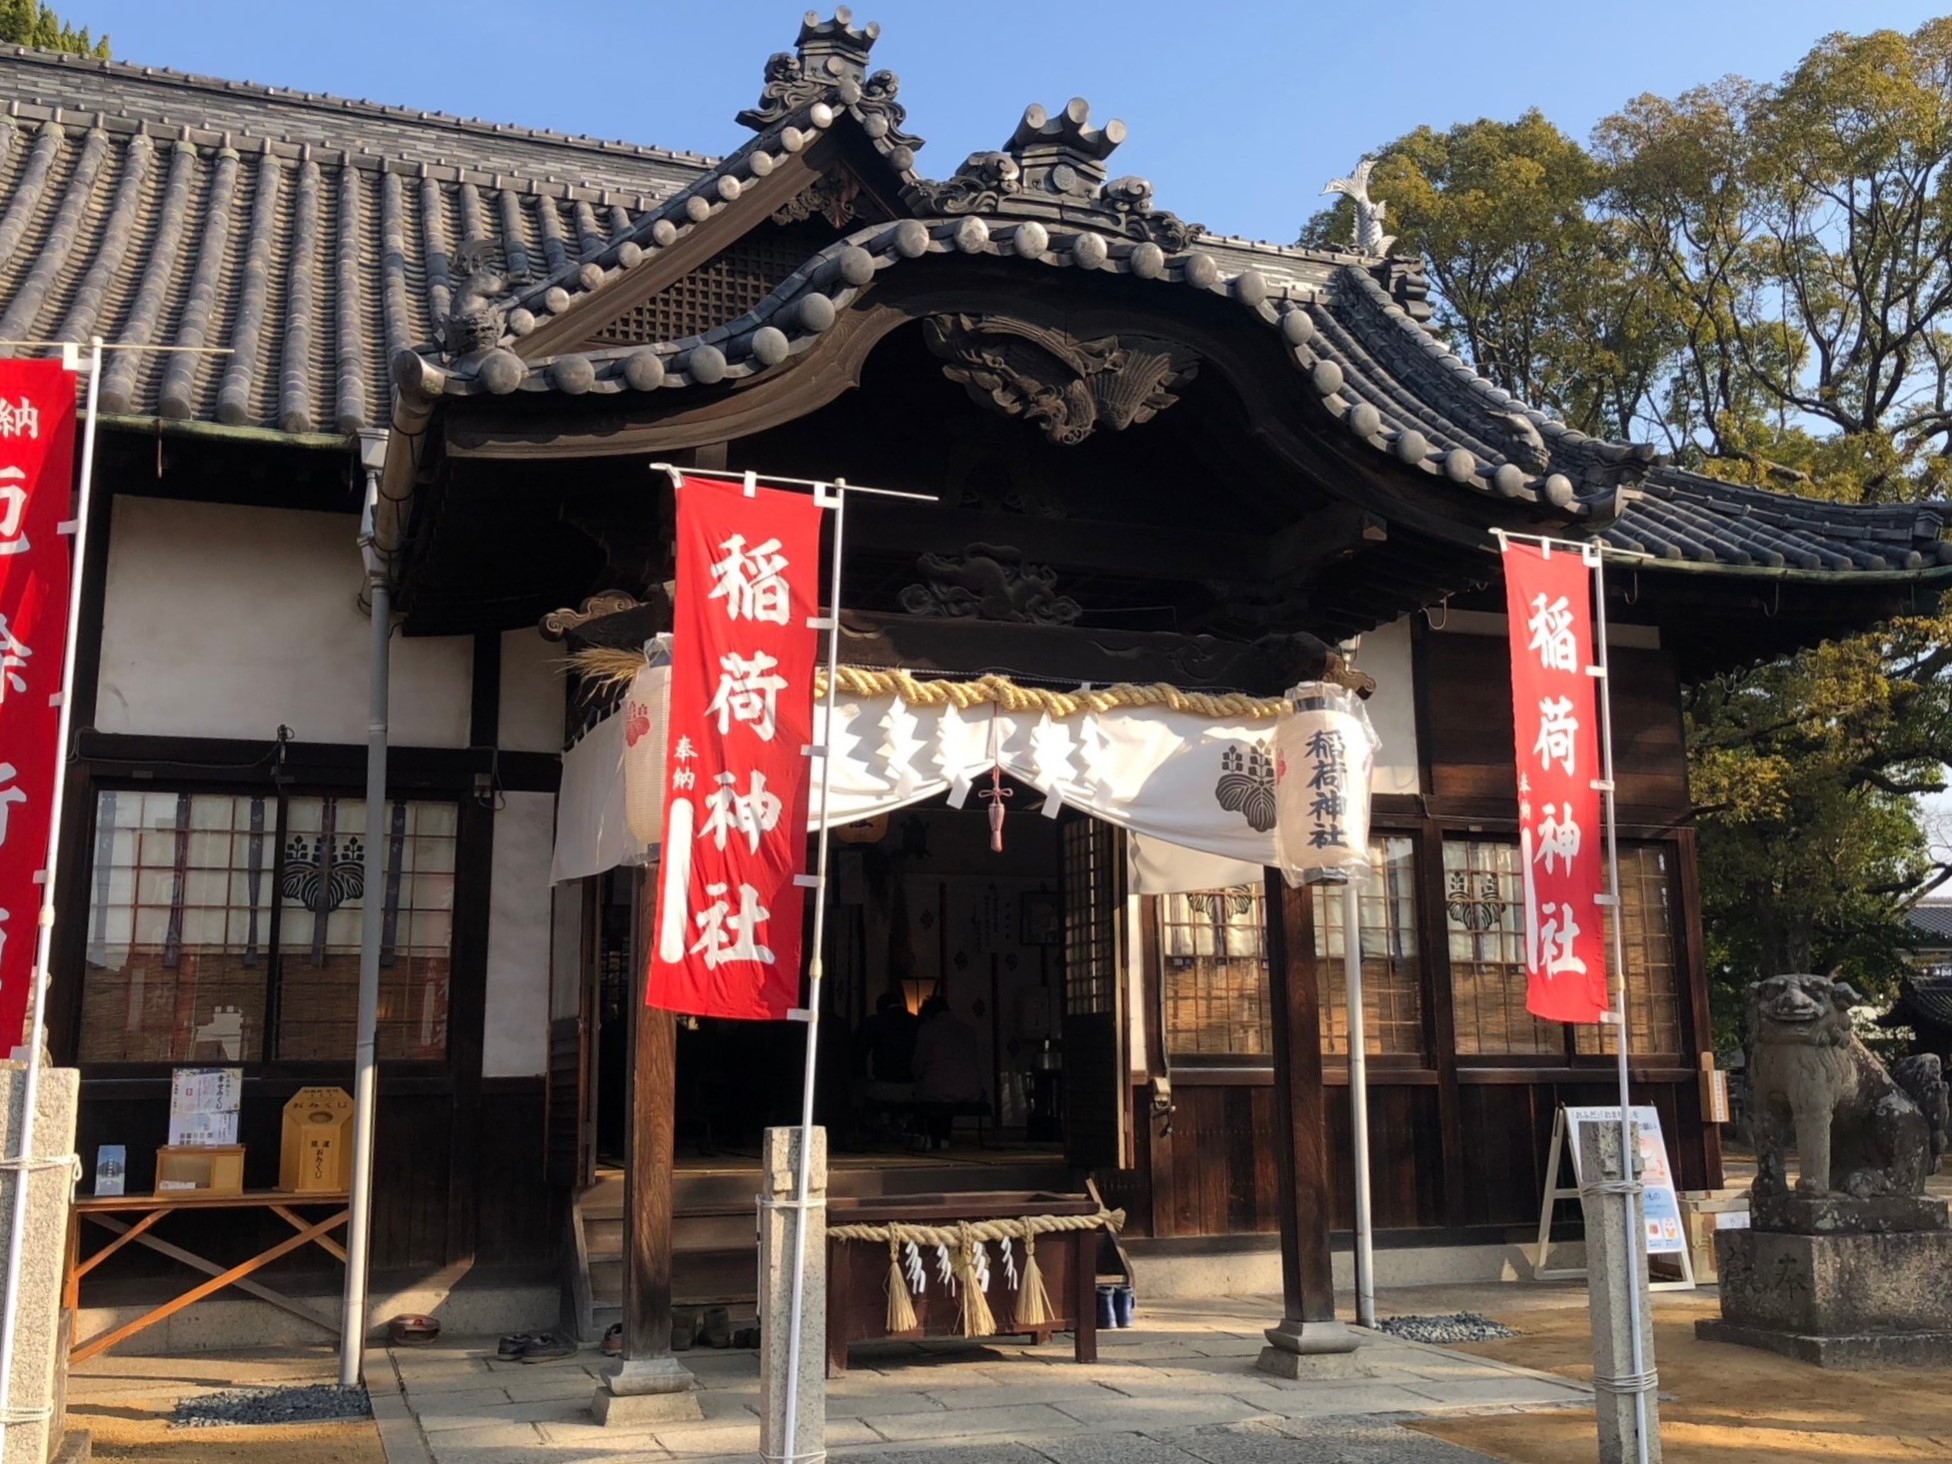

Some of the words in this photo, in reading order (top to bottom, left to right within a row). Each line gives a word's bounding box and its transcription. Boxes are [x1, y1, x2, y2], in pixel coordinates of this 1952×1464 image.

[672, 735, 699, 791] 奉納
[689, 533, 790, 971] 稲荷神社
[1304, 729, 1348, 849] 稲荷神社
[1528, 591, 1588, 981] 稲荷神社
